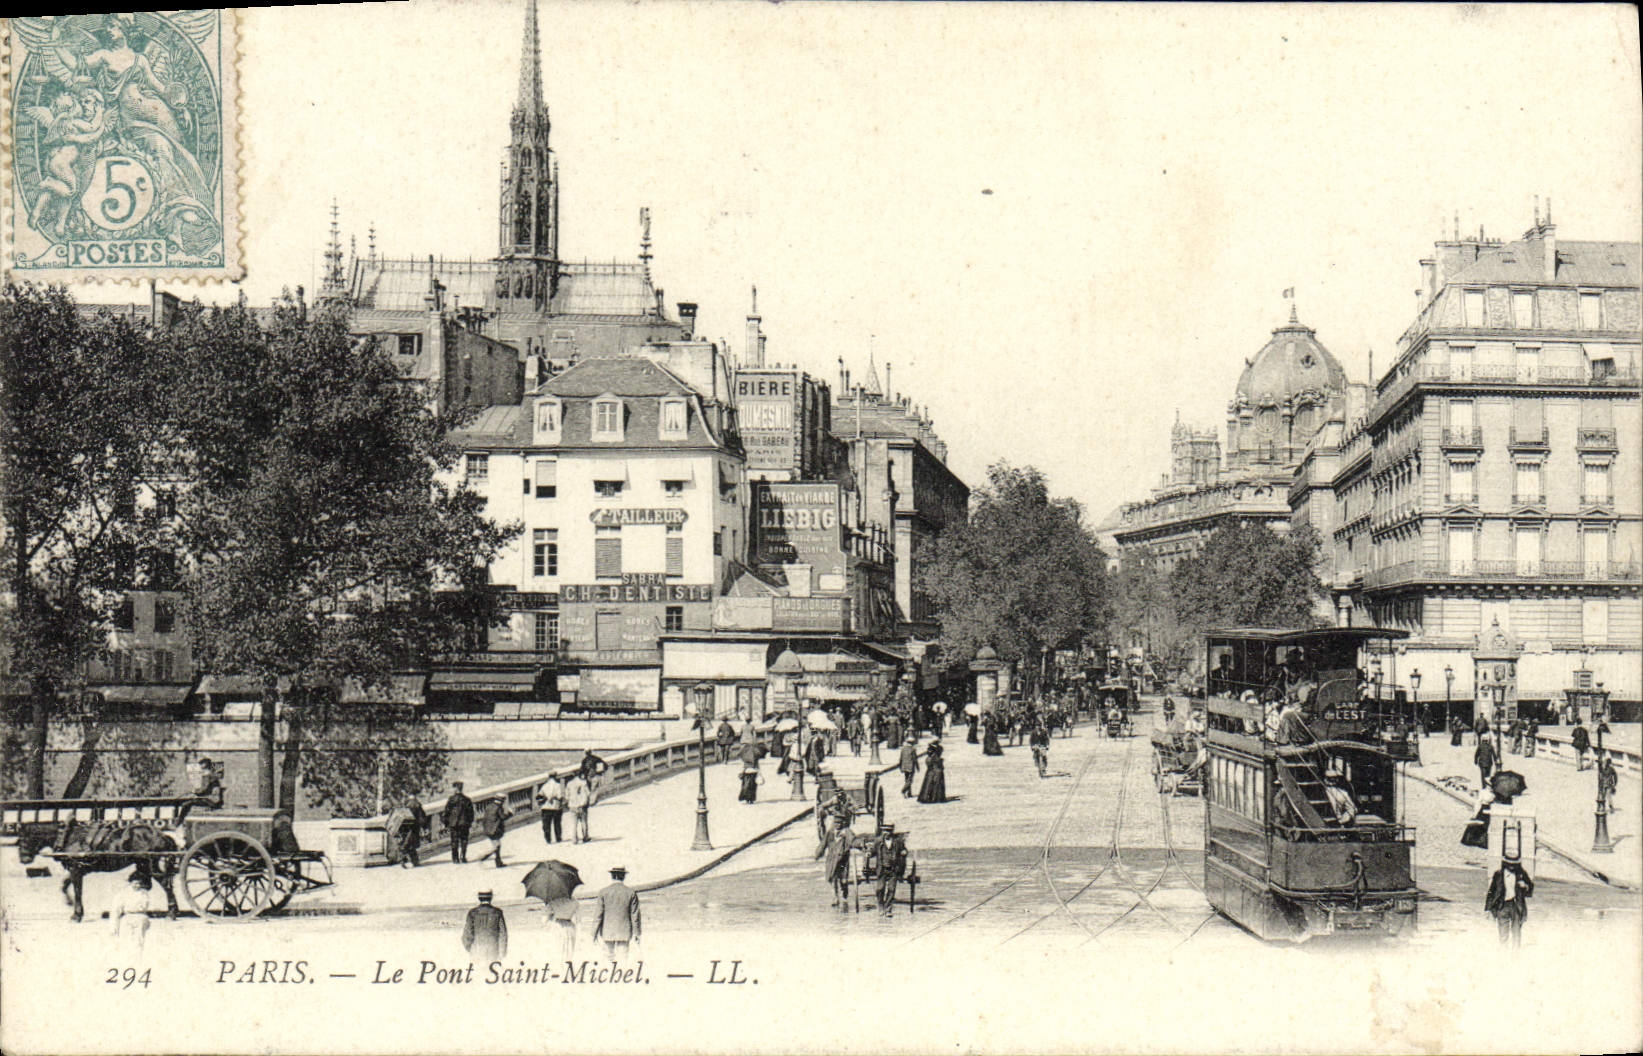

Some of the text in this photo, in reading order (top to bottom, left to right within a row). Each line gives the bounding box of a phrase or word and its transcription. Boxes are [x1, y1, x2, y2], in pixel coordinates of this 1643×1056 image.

[71, 242, 164, 264] POSTES
[609, 508, 684, 523] TAILLEUR
[760, 508, 836, 530] LIEBIG
[622, 573, 666, 586] SABRA
[609, 585, 710, 601] DENTISTE
